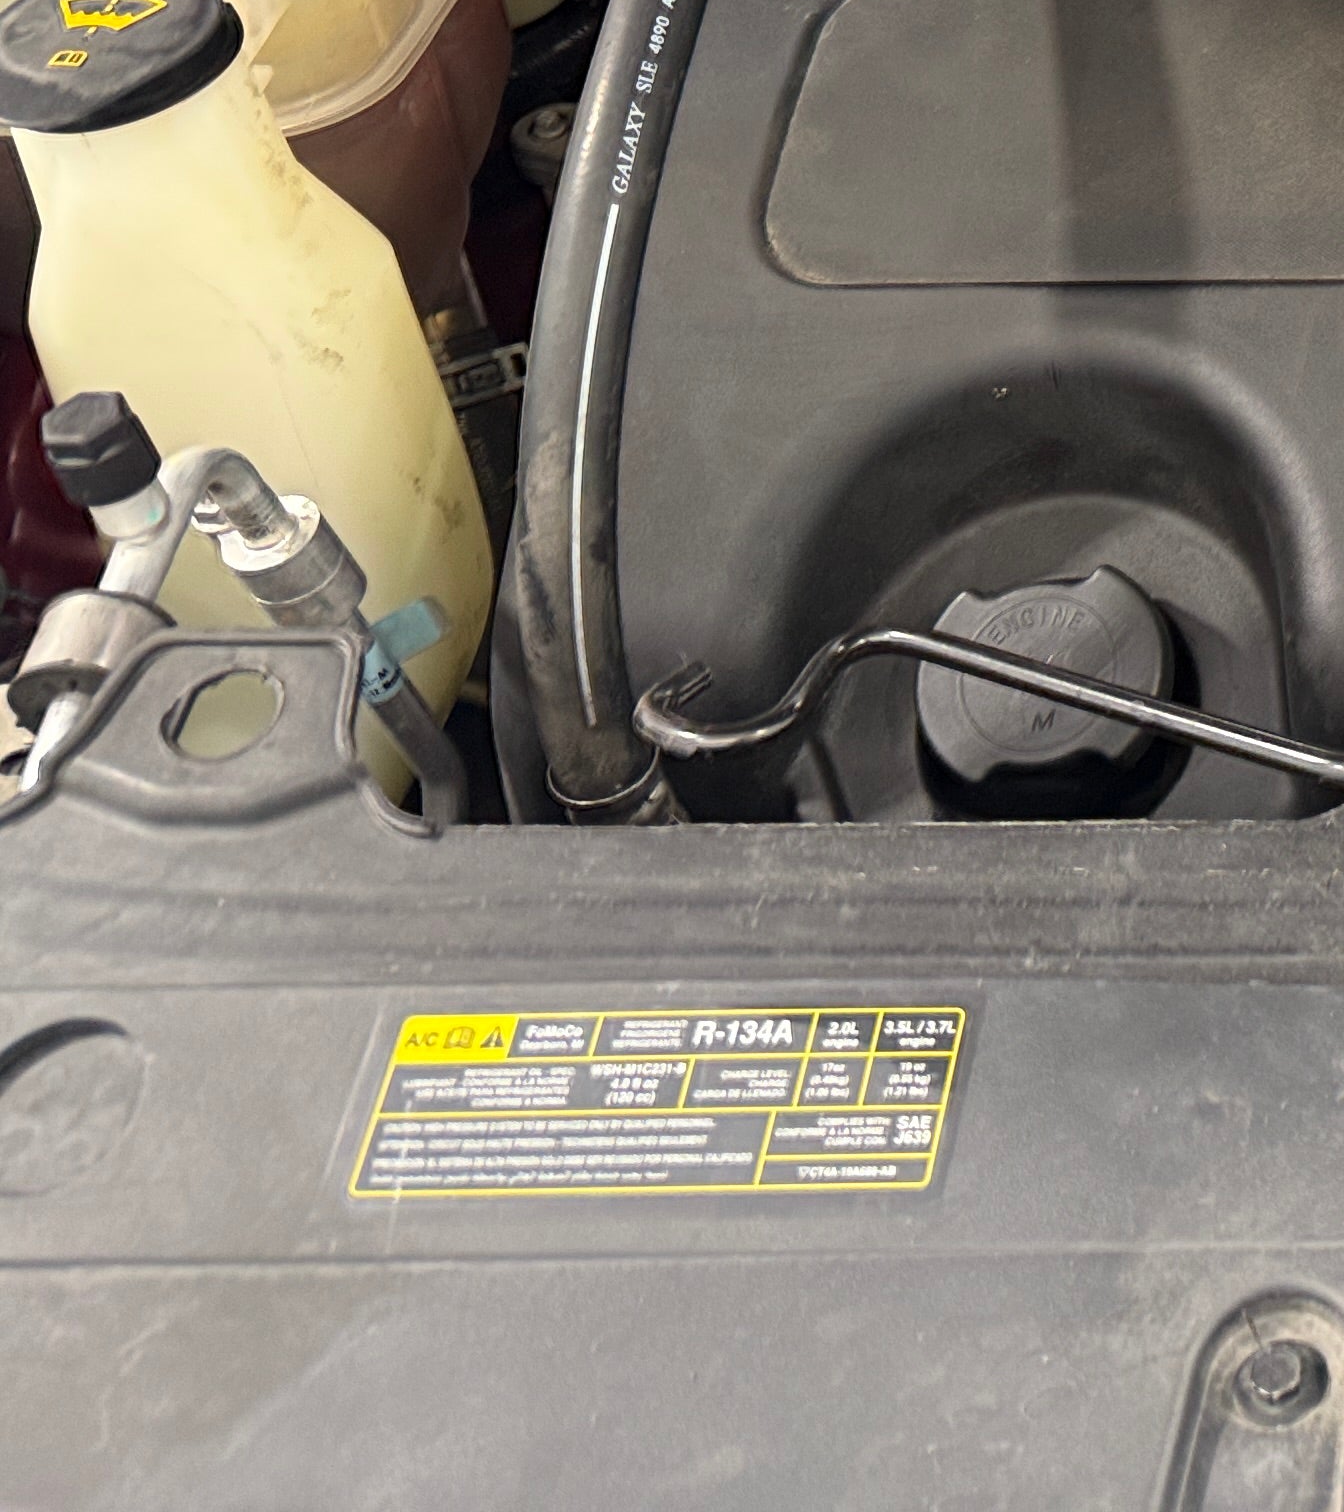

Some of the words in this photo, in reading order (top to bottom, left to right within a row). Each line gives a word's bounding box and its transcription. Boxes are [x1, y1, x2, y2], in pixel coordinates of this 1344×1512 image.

[611, 100, 646, 196] GALAXY
[635, 59, 658, 94] SLE
[648, 15, 670, 55] 4890
[986, 606, 1087, 645] ENGINE
[525, 1024, 584, 1038] FoMoCo
[692, 1018, 794, 1046] R-134A
[827, 1021, 860, 1035] 2.0L
[883, 1019, 915, 1035] 3.5L
[925, 1019, 957, 1035] 3.7L
[404, 1031, 440, 1048] A/C
[822, 1036, 860, 1049] engine
[897, 1036, 936, 1048] engine
[896, 1114, 933, 1130] SAE
[893, 1129, 932, 1146] J639
